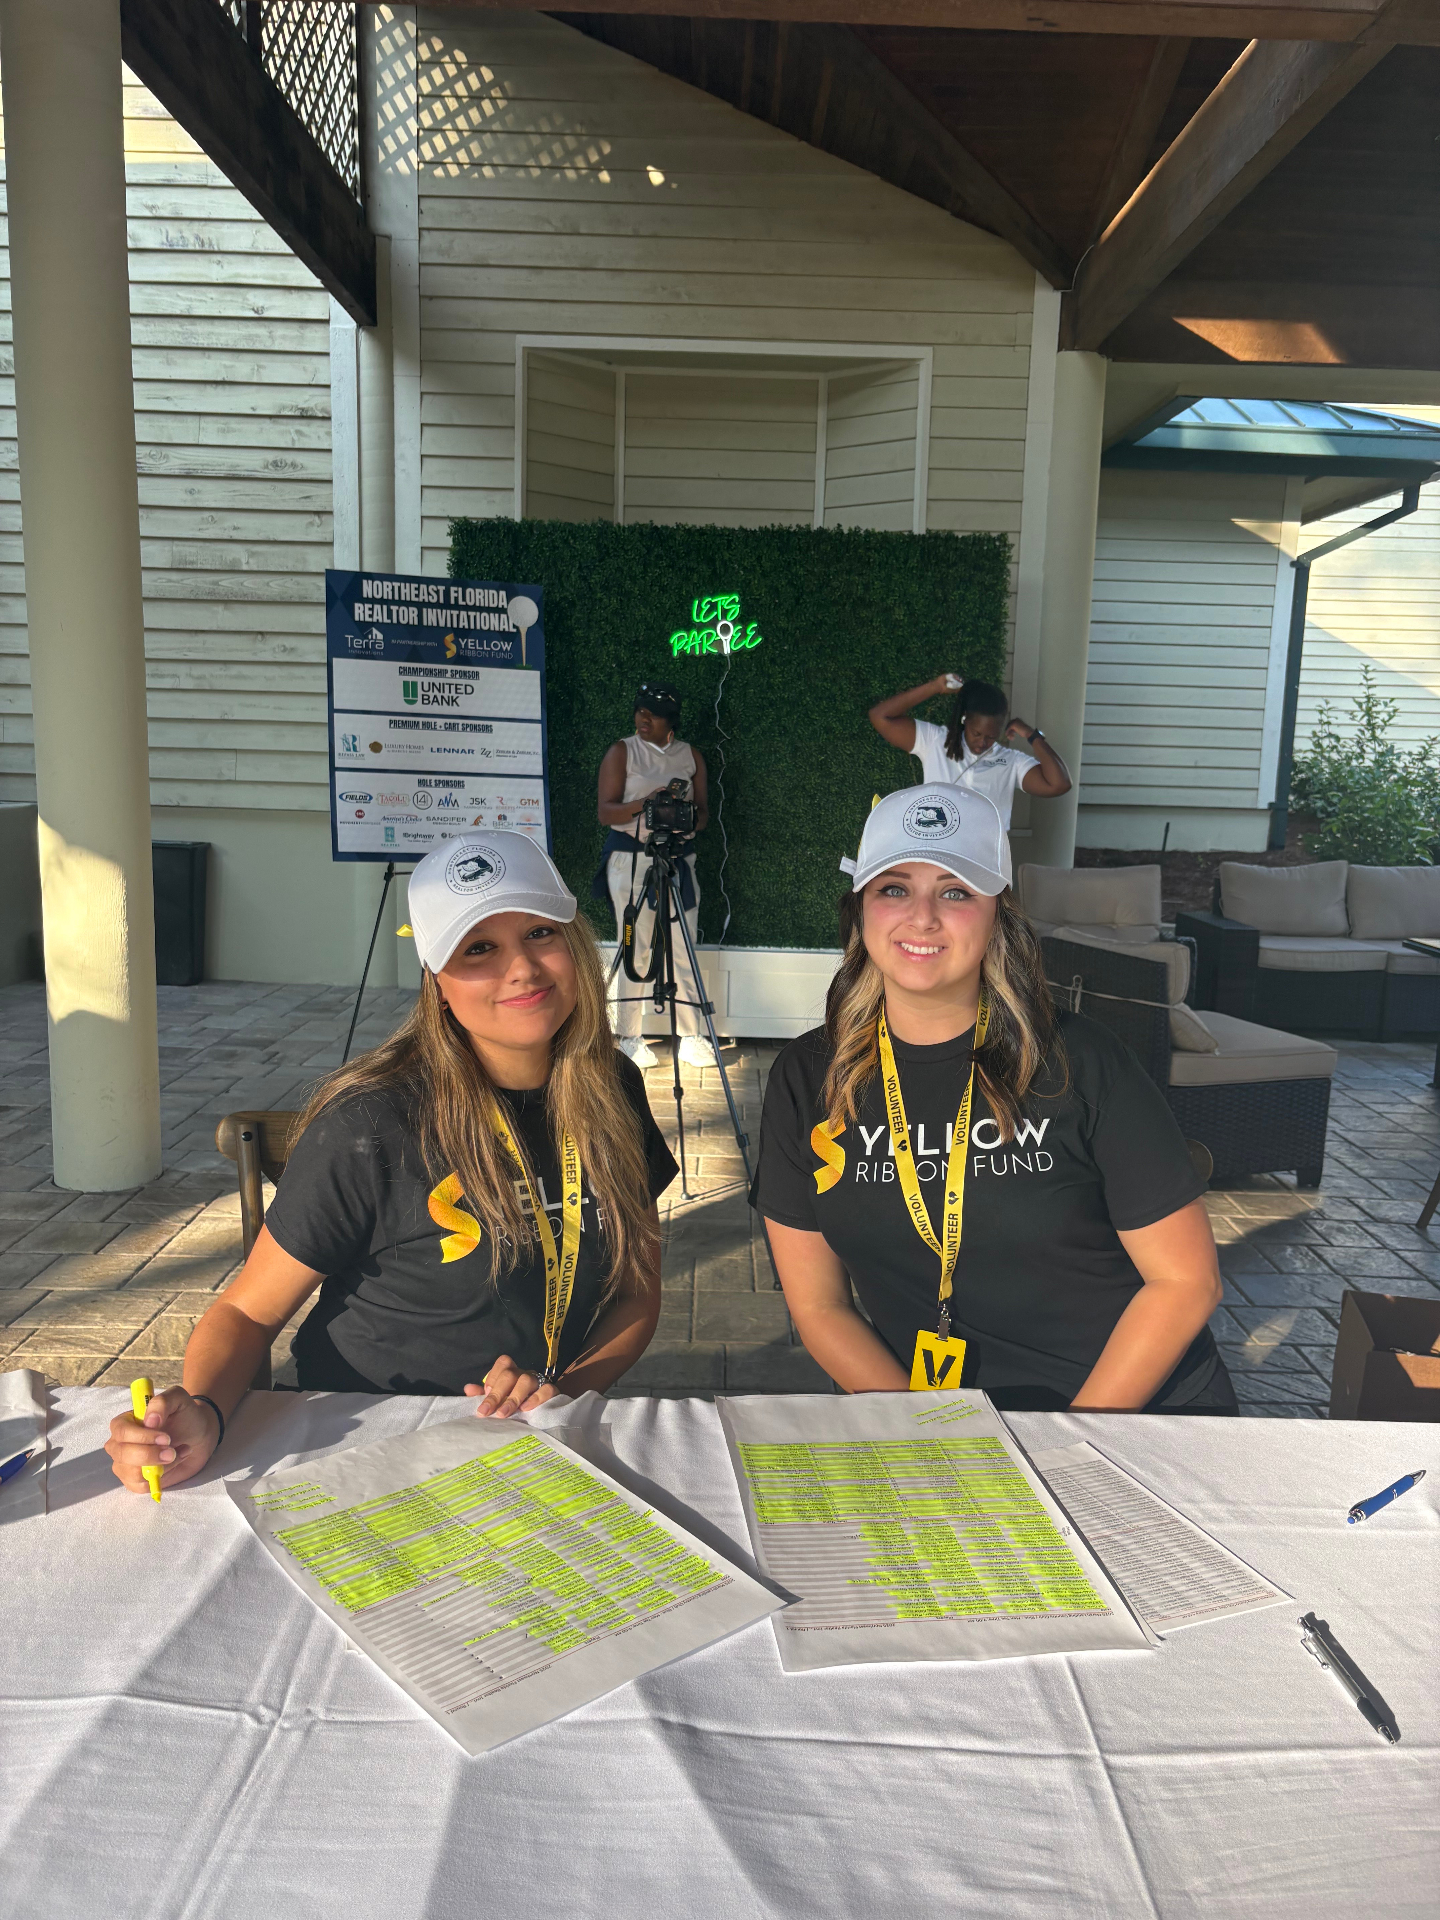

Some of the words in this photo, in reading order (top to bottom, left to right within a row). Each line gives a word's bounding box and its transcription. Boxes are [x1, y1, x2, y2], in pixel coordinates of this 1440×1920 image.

[362, 580, 445, 604] NORTHEAST
[450, 587, 507, 609] FLORIDA
[355, 603, 418, 625] REALTOR
[423, 608, 517, 632] INVITATIONAL
[345, 635, 385, 650] Terra
[458, 638, 513, 651] YELLOW
[460, 650, 489, 658] RIBBON
[399, 666, 449, 679] CHAMPIONSHIP
[450, 669, 480, 680] SPONSOR
[421, 681, 474, 695] UNITED
[421, 695, 460, 707] BANK
[389, 719, 420, 729] PREMIUM
[421, 721, 437, 731] HOLE
[444, 722, 460, 732] CART
[461, 723, 493, 733] SPONSORS
[430, 747, 475, 755] LENNAR
[418, 779, 433, 787] HOLE
[434, 780, 465, 788] SPONSORS
[345, 794, 368, 802] FIELDS
[470, 798, 486, 806] JSK
[886, 1074, 904, 1135] VOLUNTEER
[974, 1152, 1054, 1178] FUND
[556, 1252, 575, 1320] VOLUNTEER
